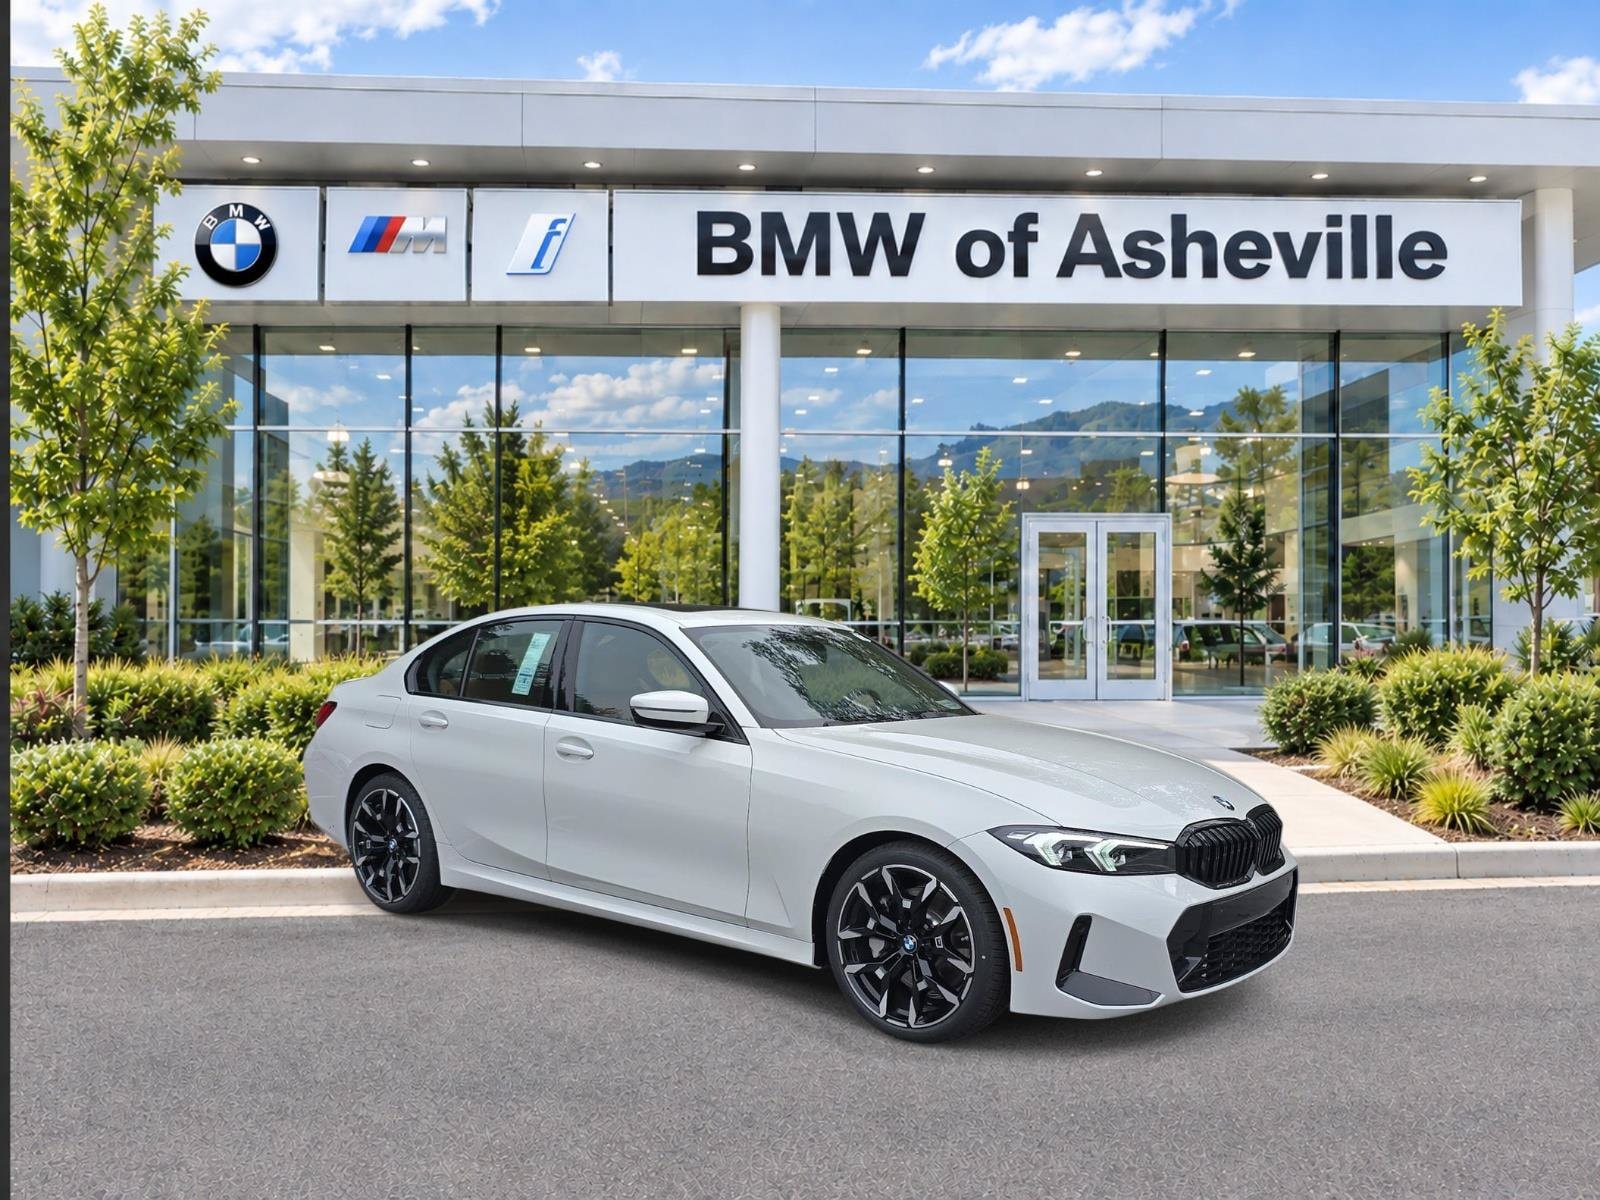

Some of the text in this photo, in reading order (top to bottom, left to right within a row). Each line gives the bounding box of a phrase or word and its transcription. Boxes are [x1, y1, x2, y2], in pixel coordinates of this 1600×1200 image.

[202, 203, 271, 231] BMW
[696, 210, 1448, 281] BMW of Asheville
